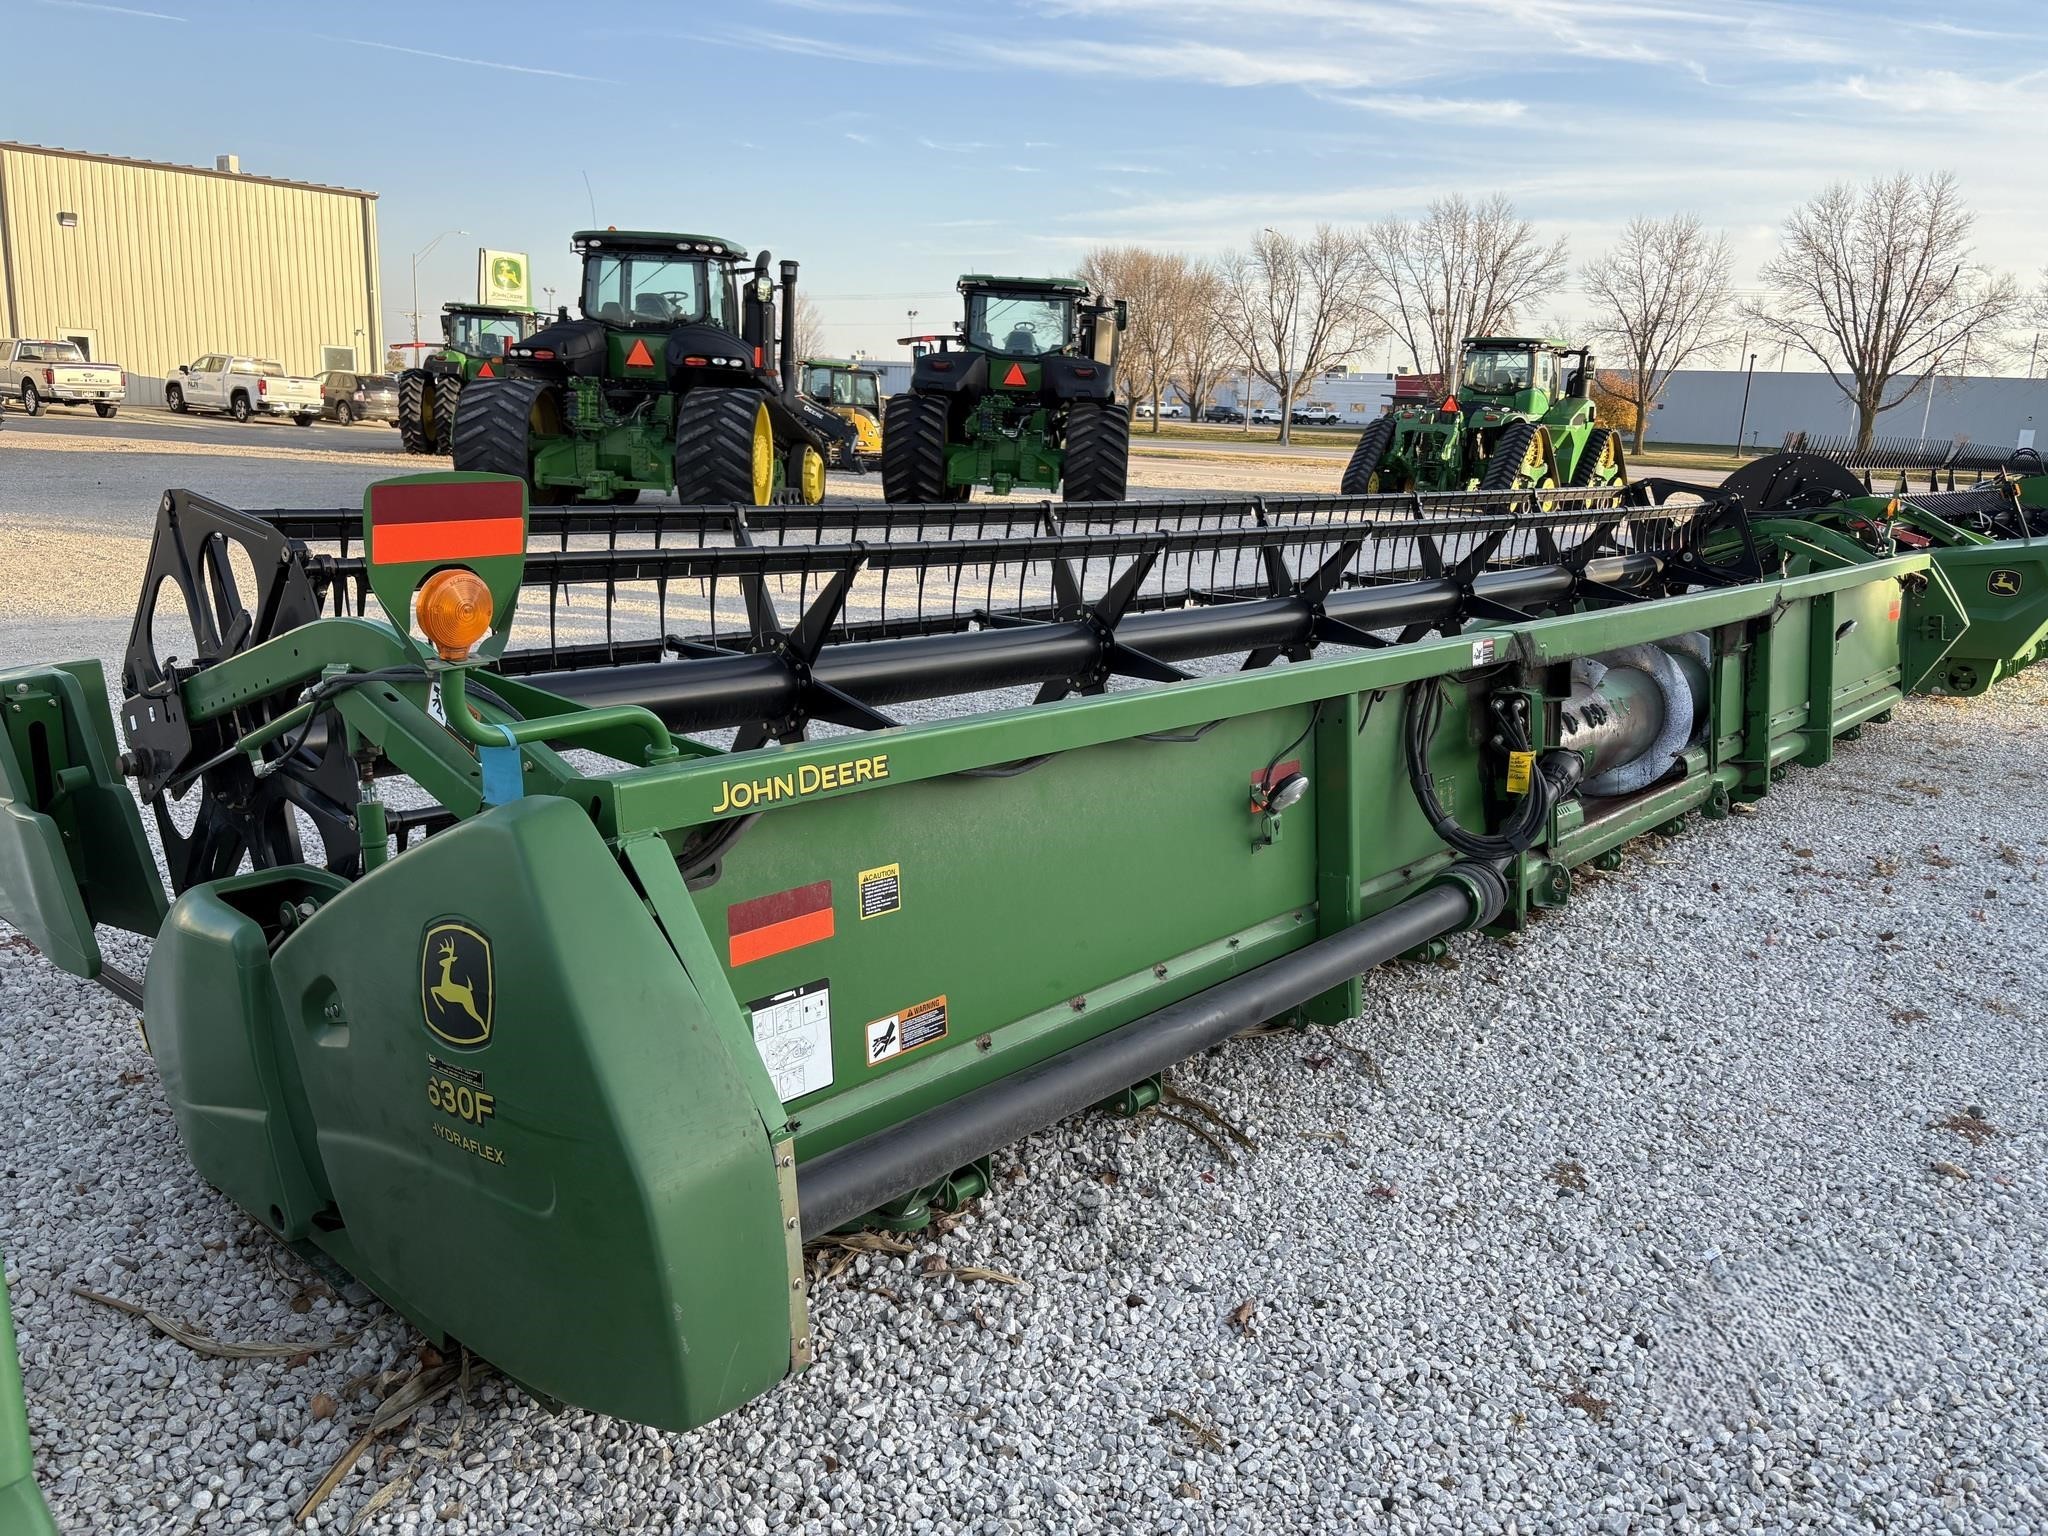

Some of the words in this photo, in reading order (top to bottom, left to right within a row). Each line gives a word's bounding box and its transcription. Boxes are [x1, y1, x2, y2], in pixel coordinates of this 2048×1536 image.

[803, 405, 825, 420] DEERE
[712, 773, 796, 814] JOHN
[797, 754, 890, 795] DEERE
[868, 868, 896, 881] CAUTION
[913, 999, 940, 1014] WARNING
[428, 1075, 495, 1125] 630F
